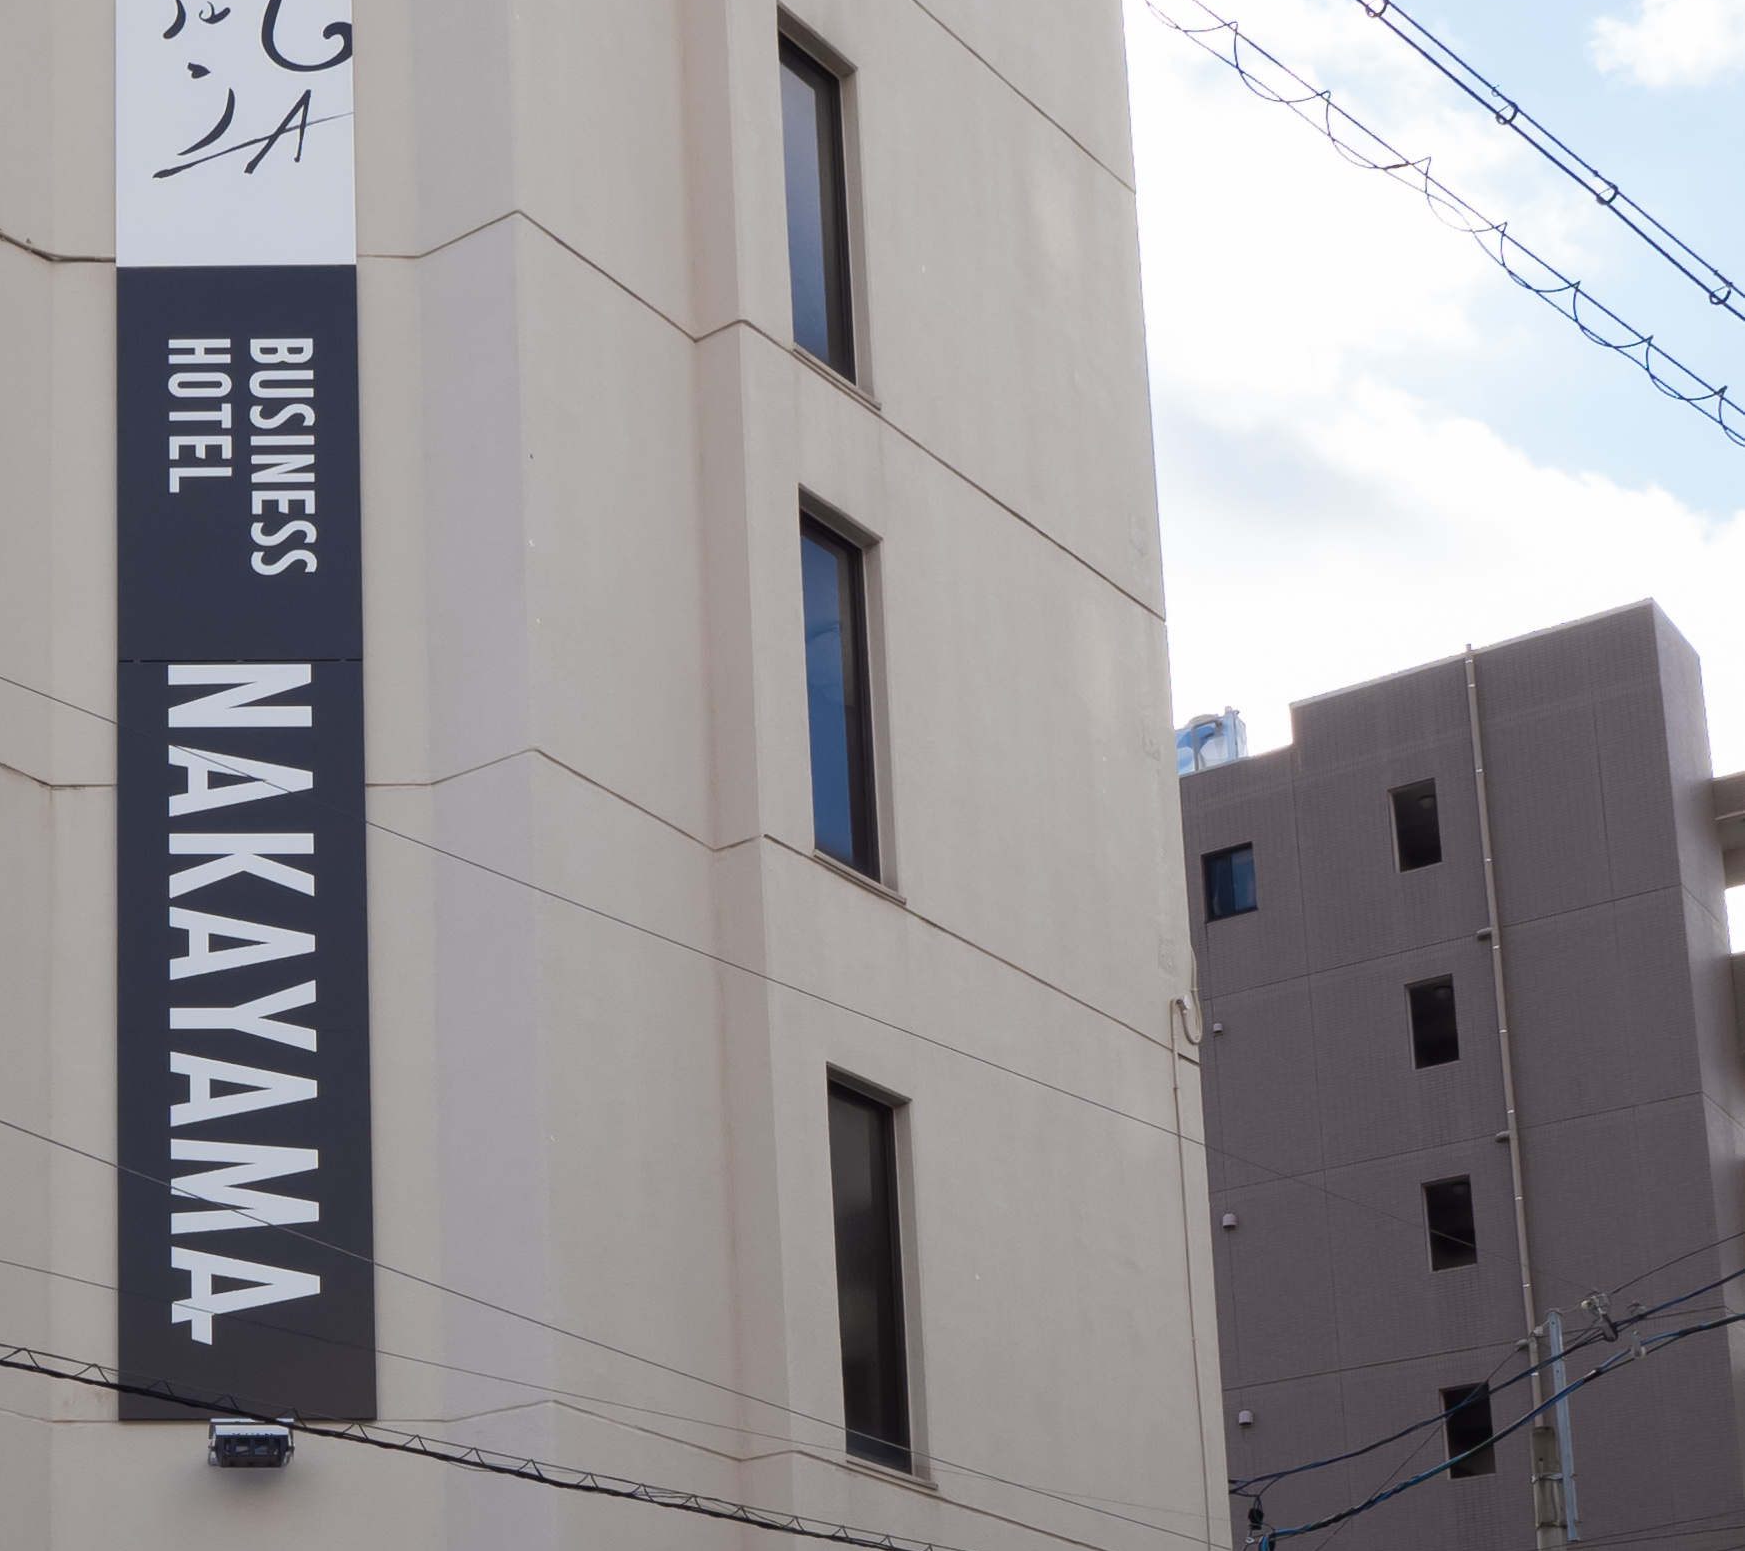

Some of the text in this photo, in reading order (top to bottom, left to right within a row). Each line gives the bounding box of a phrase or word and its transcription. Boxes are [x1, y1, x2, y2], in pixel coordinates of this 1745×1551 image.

[167, 336, 233, 494] HOTEL
[249, 336, 318, 577] BUSINESS
[167, 663, 321, 1346] NAKAYAMA
